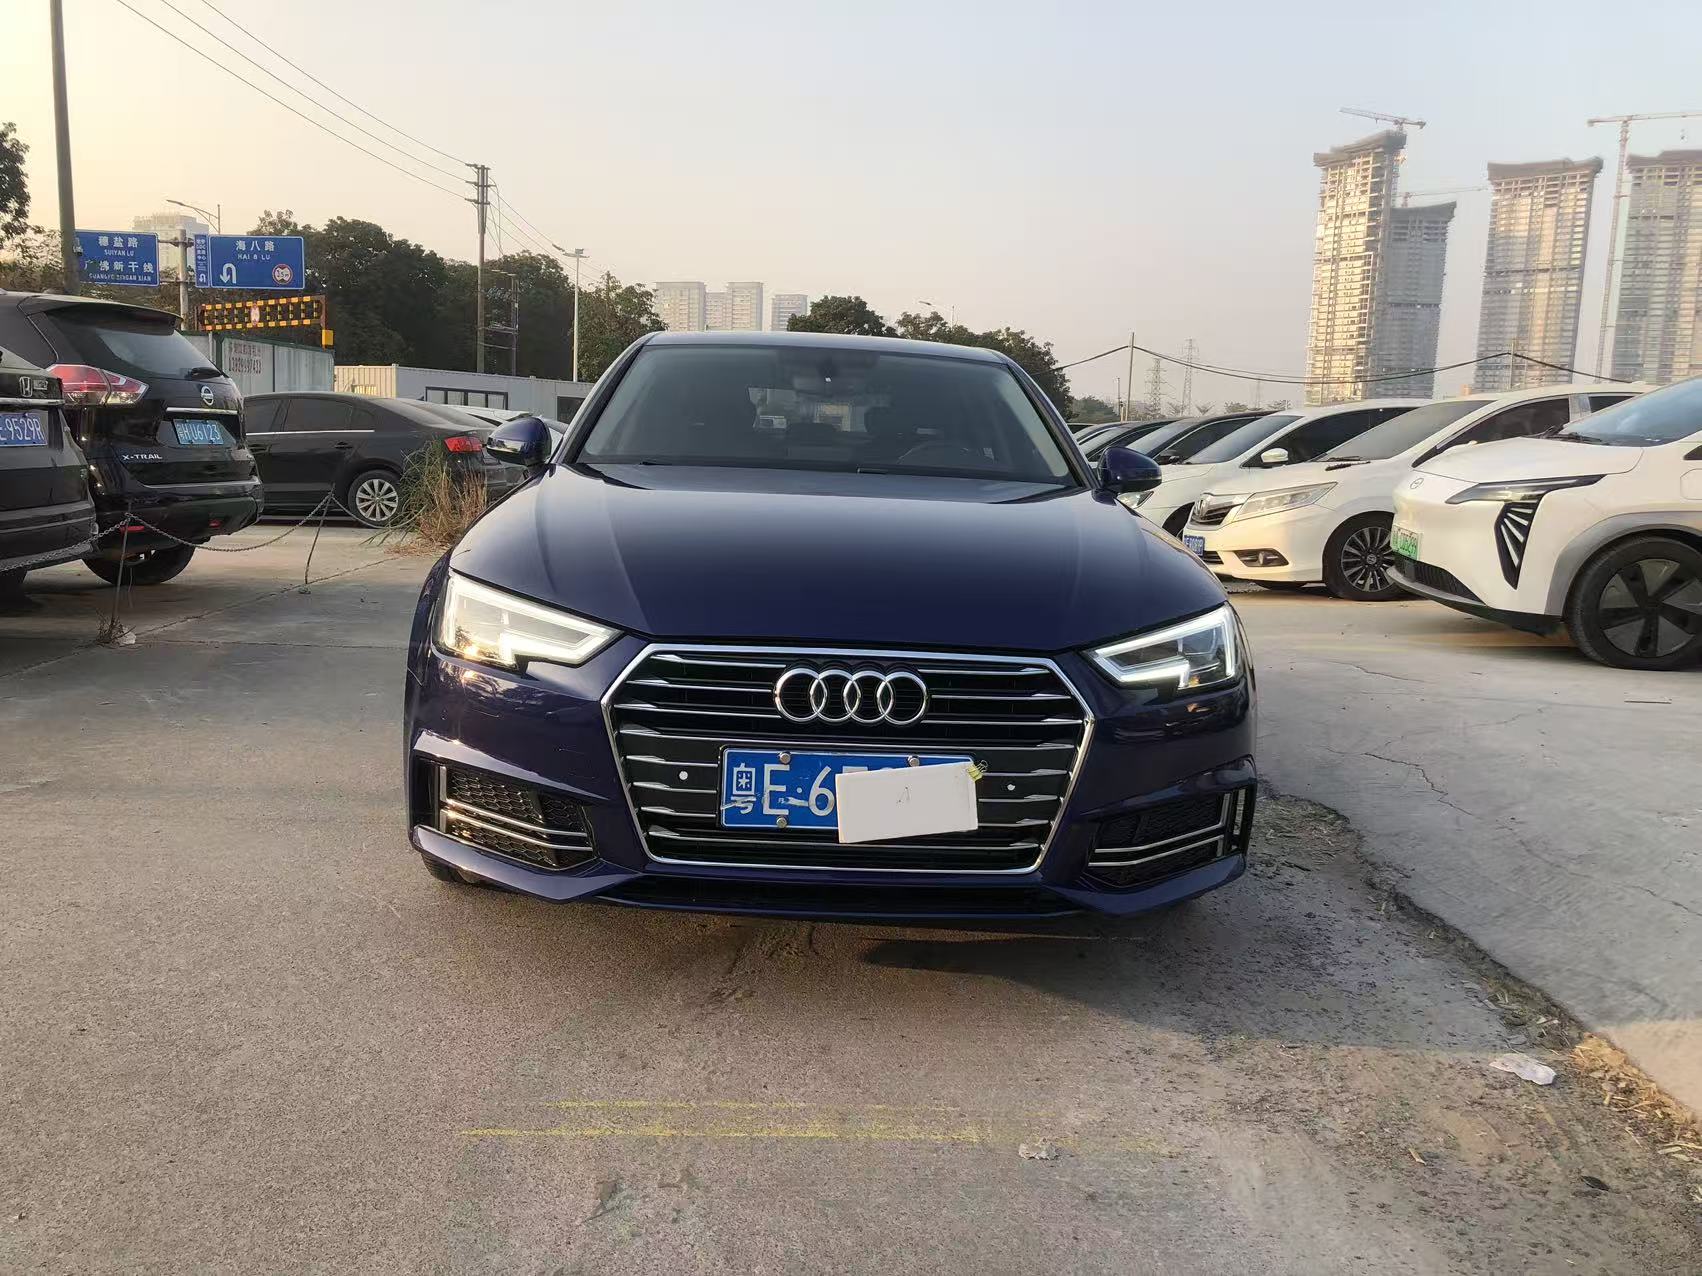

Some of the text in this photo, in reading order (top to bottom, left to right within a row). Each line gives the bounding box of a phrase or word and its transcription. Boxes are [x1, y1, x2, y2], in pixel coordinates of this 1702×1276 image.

[236, 240, 275, 252] 海八路
[84, 259, 154, 273] 广佛新干线
[121, 453, 163, 461] X-TRAIL
